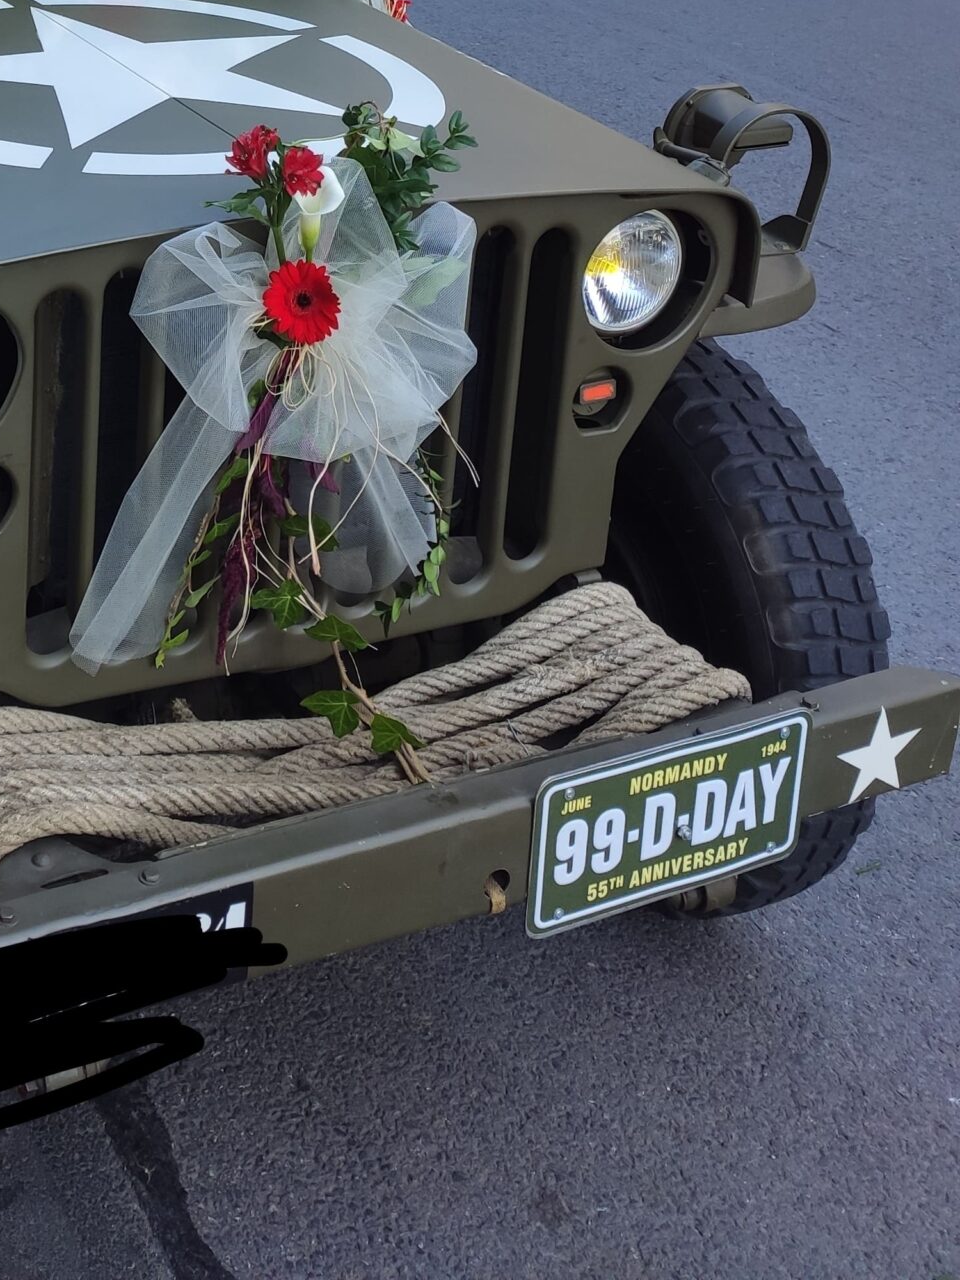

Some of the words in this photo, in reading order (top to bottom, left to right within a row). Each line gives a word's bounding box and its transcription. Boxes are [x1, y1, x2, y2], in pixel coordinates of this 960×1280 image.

[760, 739, 788, 758] 1944
[628, 752, 729, 797] NORMANDY
[553, 756, 792, 887] 99-D-DAY
[560, 795, 593, 816] JUNE
[585, 874, 625, 903] 55TH
[628, 838, 750, 890] ANNIVERSARY
